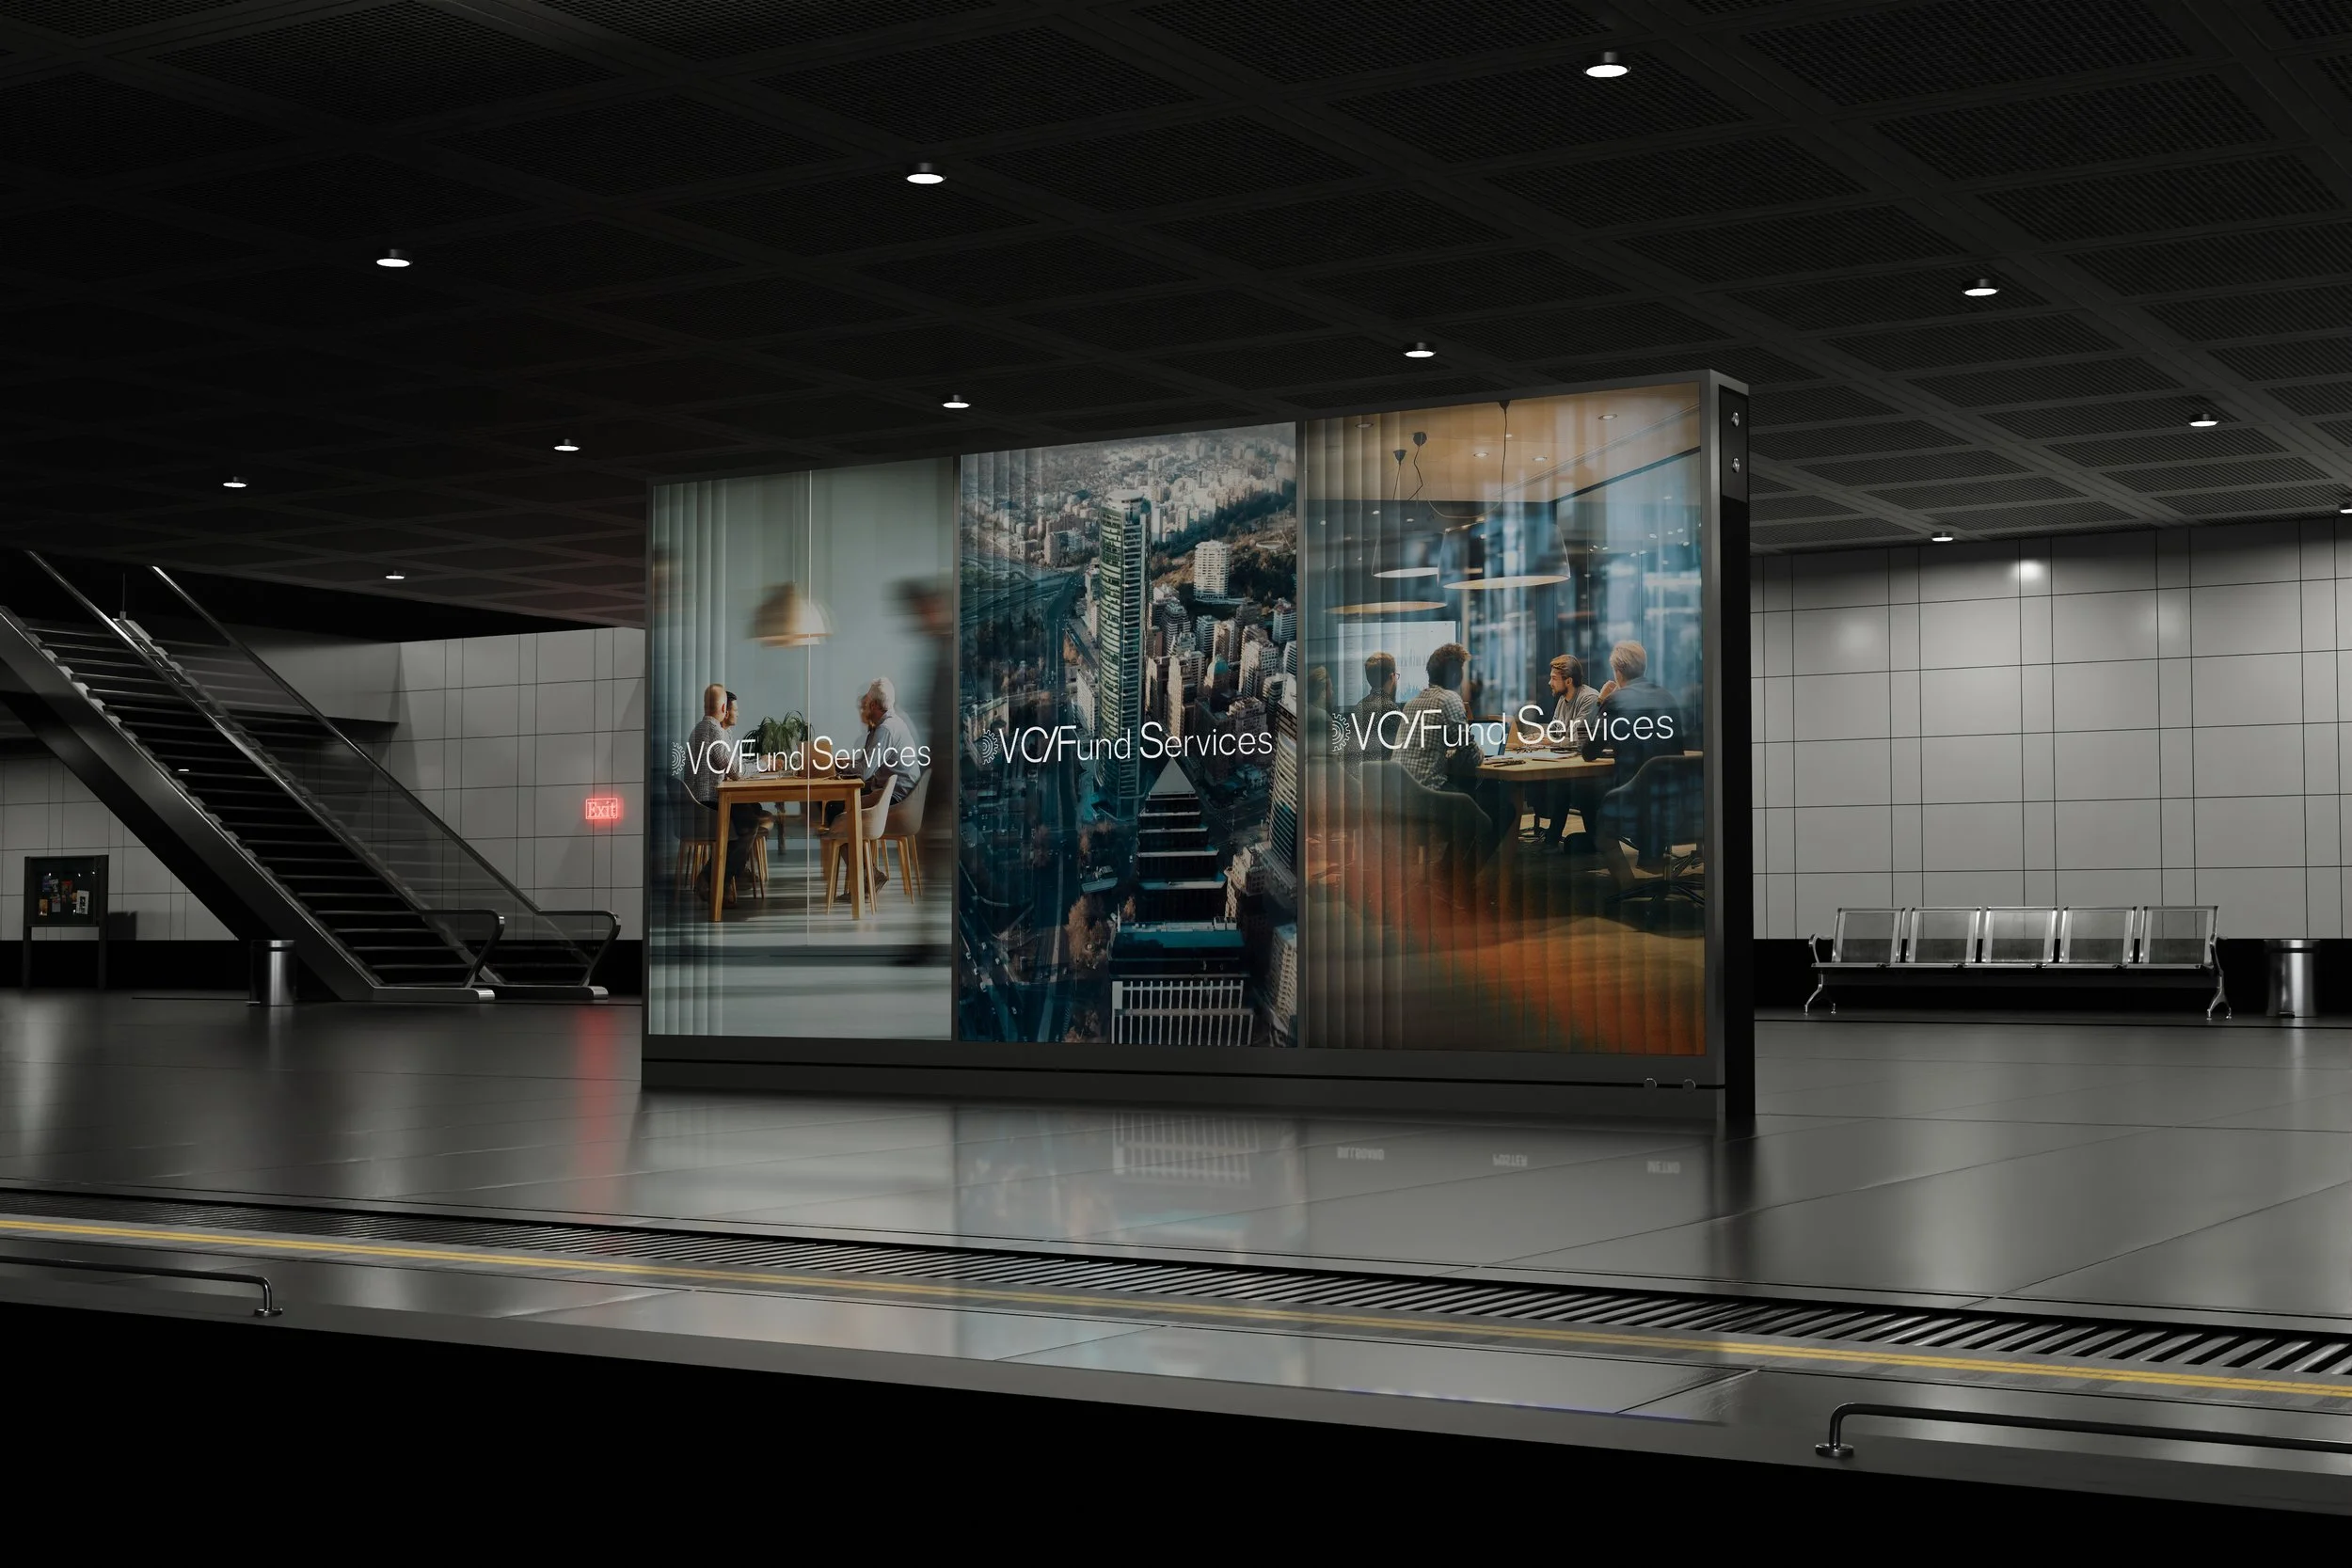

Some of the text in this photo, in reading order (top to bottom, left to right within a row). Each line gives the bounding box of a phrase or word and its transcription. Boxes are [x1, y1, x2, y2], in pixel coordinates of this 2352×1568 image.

[998, 721, 1273, 764] VC/Fund Services
[1350, 704, 1675, 751] VC/Fund Services
[686, 736, 931, 775] VC/Fund Services
[587, 800, 616, 818] Exit
